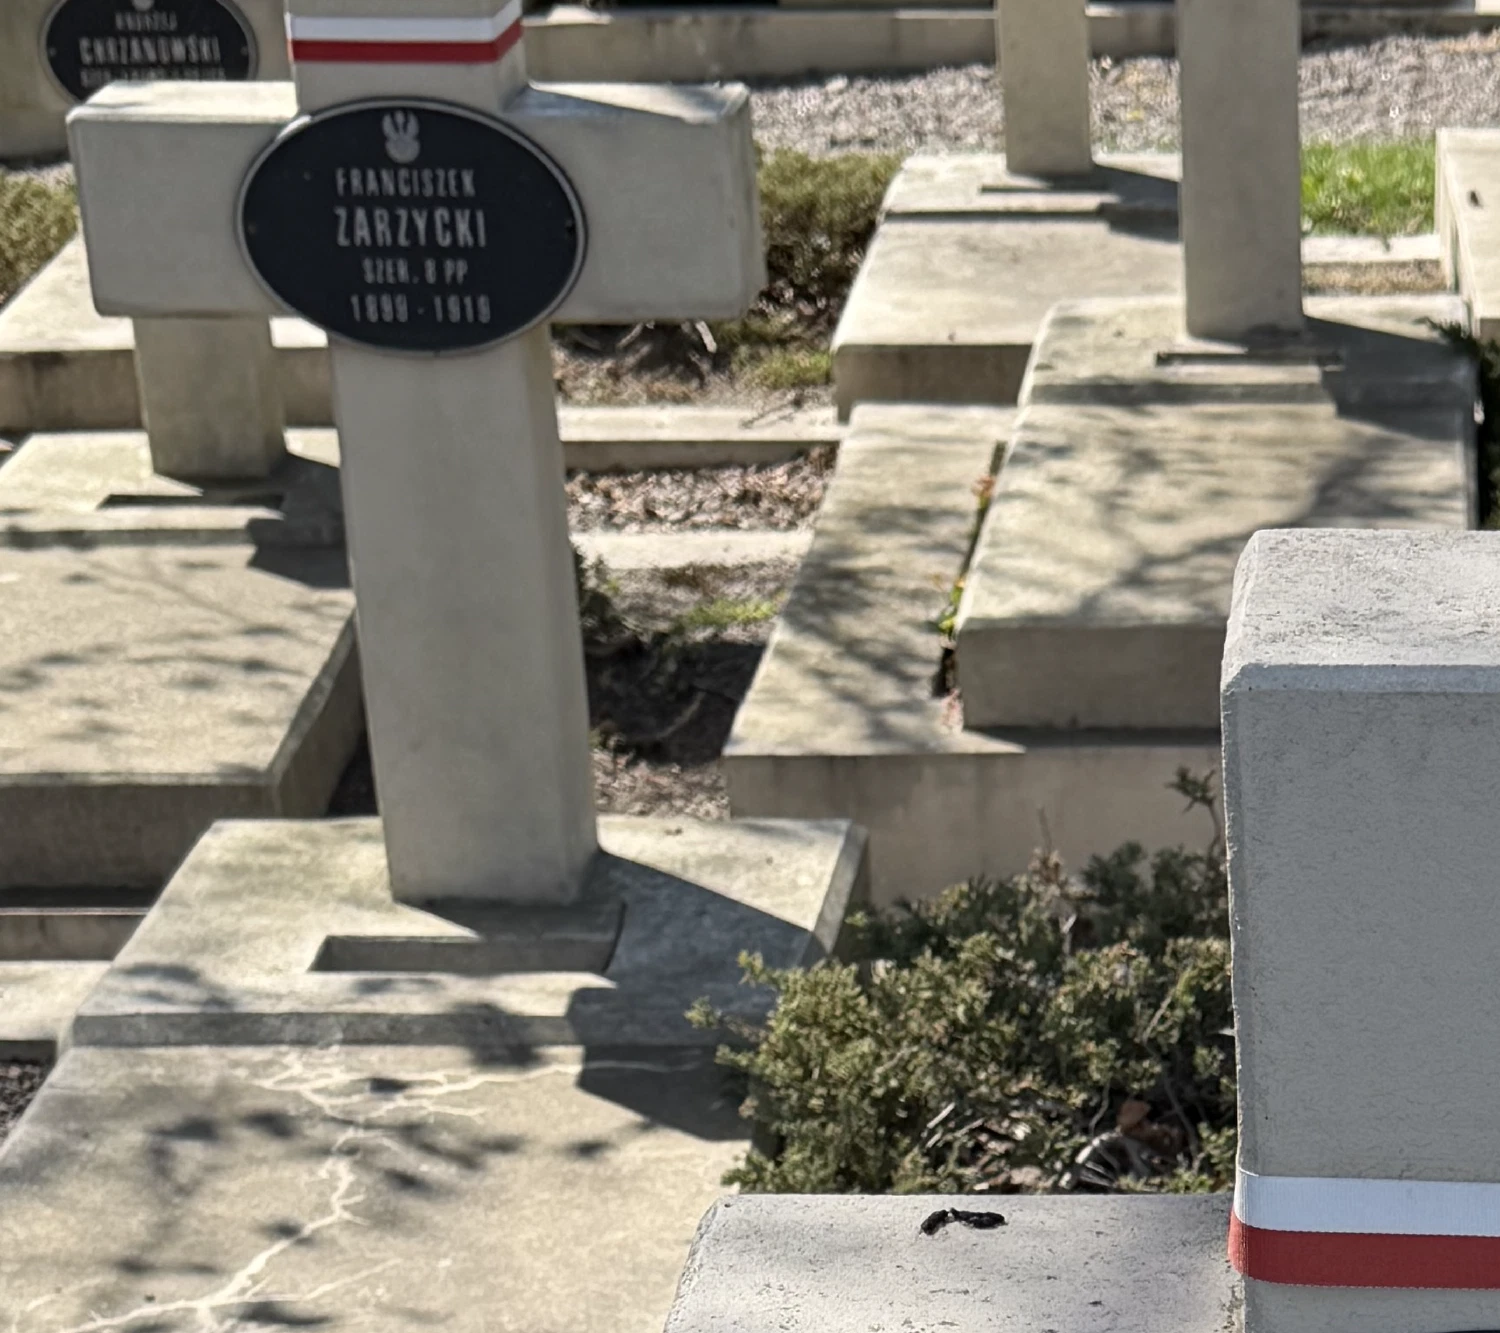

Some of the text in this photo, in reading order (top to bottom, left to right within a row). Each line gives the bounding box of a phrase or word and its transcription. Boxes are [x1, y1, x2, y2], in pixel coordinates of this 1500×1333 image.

[335, 167, 476, 197] FRANCISZEK
[333, 205, 486, 248] ZARZYCKI
[444, 256, 469, 285] PP
